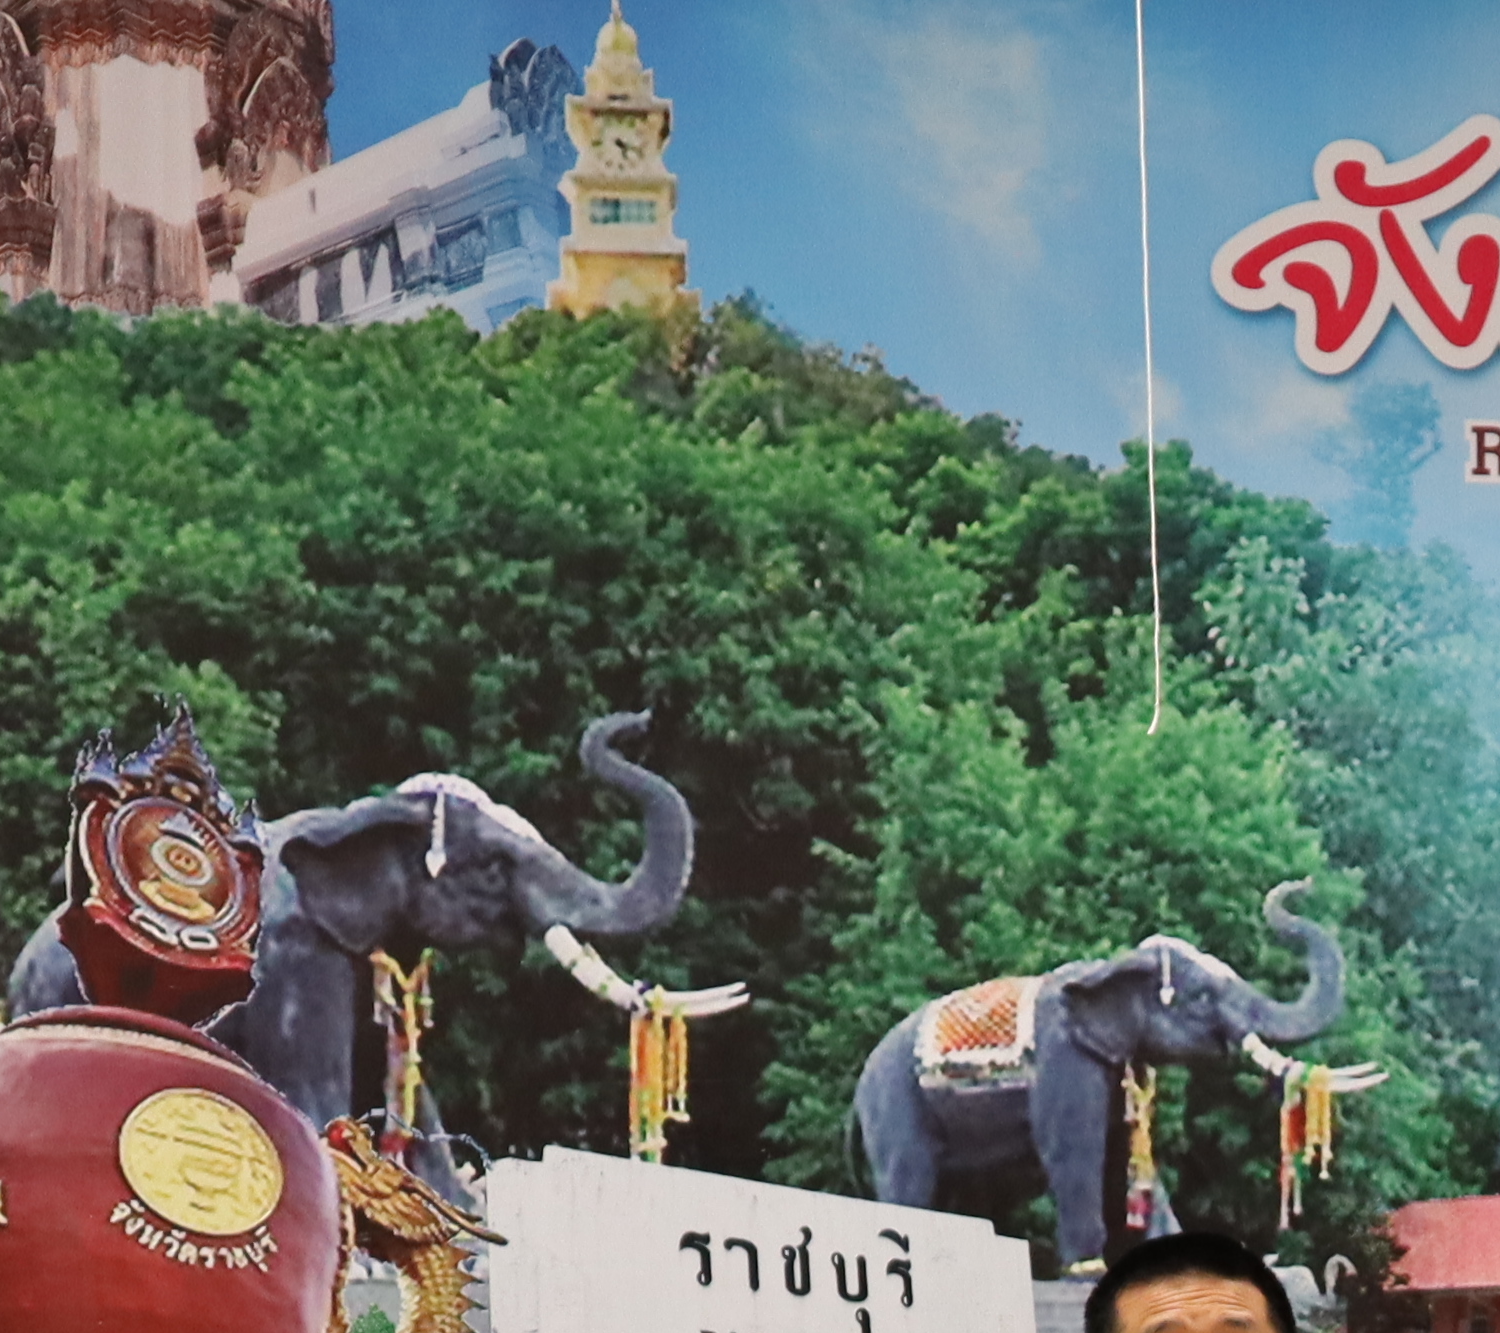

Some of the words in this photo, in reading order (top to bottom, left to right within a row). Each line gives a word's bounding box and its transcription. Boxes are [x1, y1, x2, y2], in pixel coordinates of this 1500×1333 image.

[109, 1198, 279, 1274] จังหวัดราชบุรี
